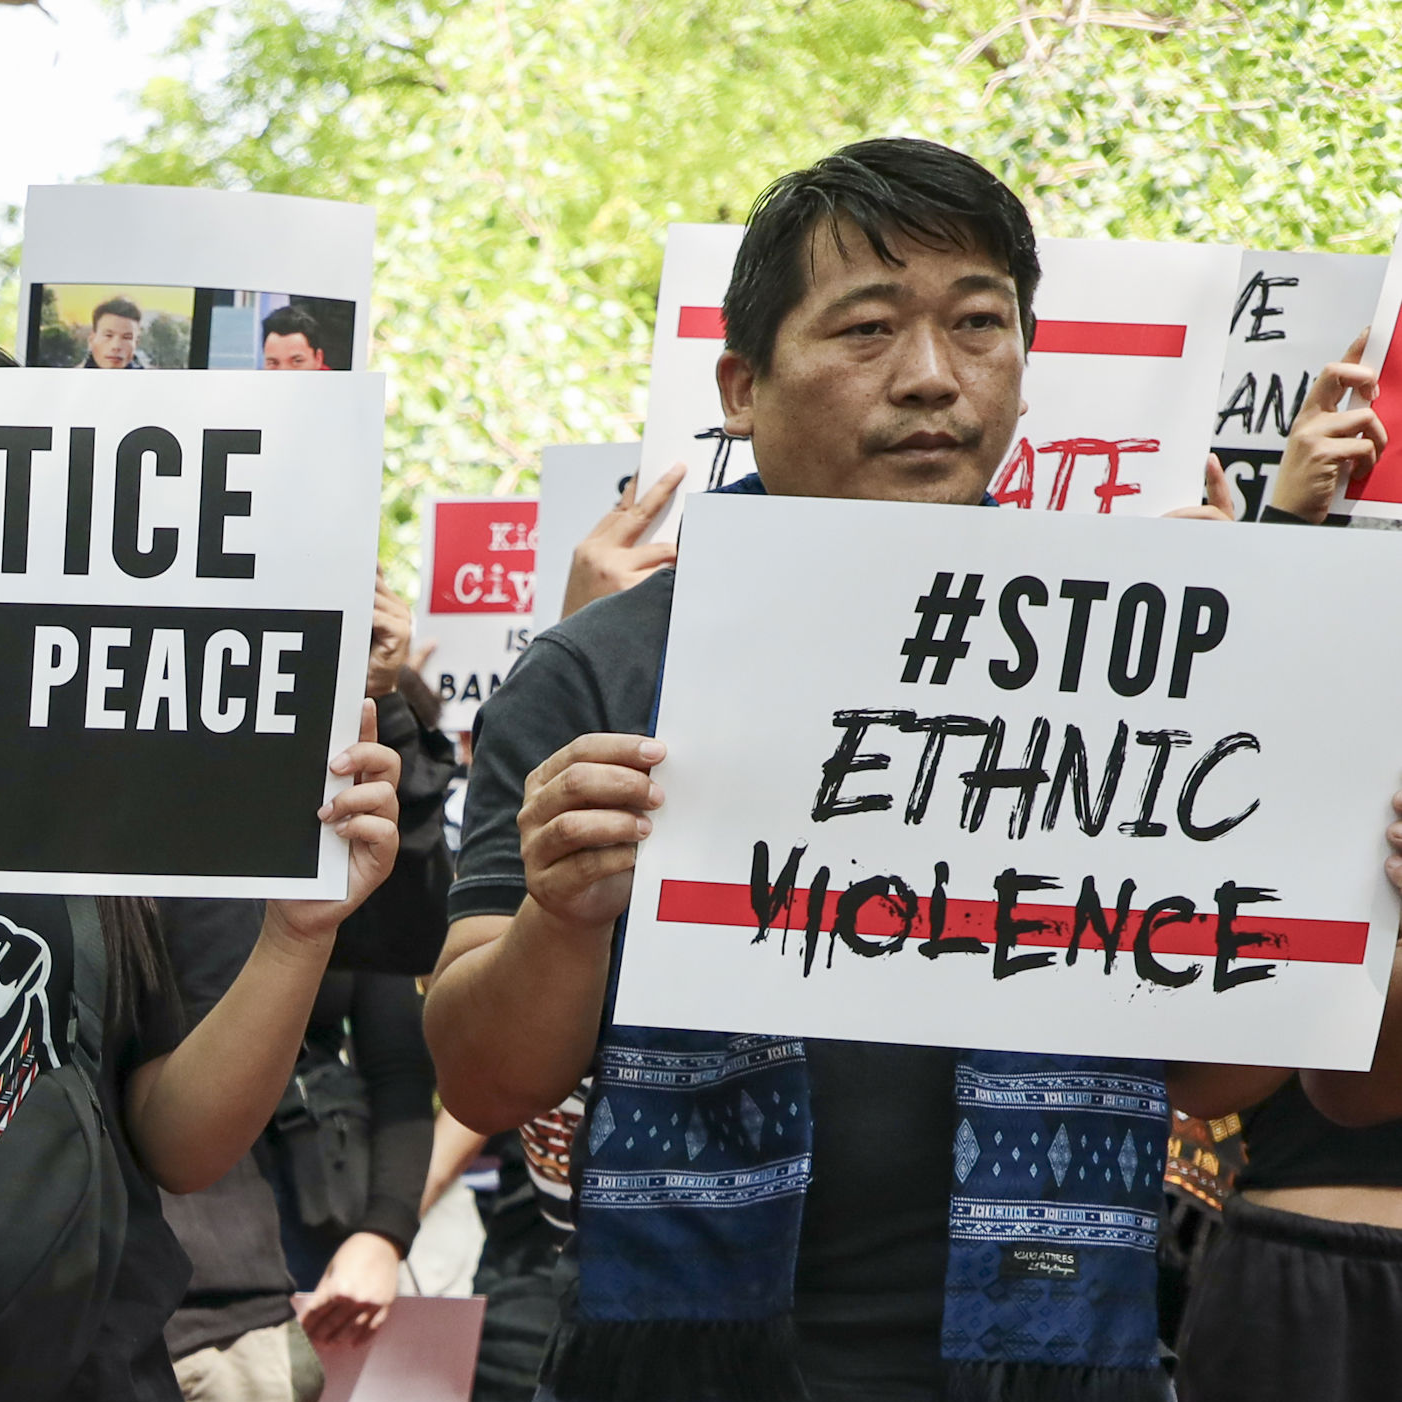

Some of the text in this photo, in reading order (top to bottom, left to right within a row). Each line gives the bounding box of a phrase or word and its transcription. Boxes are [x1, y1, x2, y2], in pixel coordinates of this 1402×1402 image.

[28, 624, 306, 735] PEACE
[899, 571, 1231, 699] #STOP
[811, 707, 1262, 842] ETHNIC
[749, 840, 1288, 993] VIOLENCE
